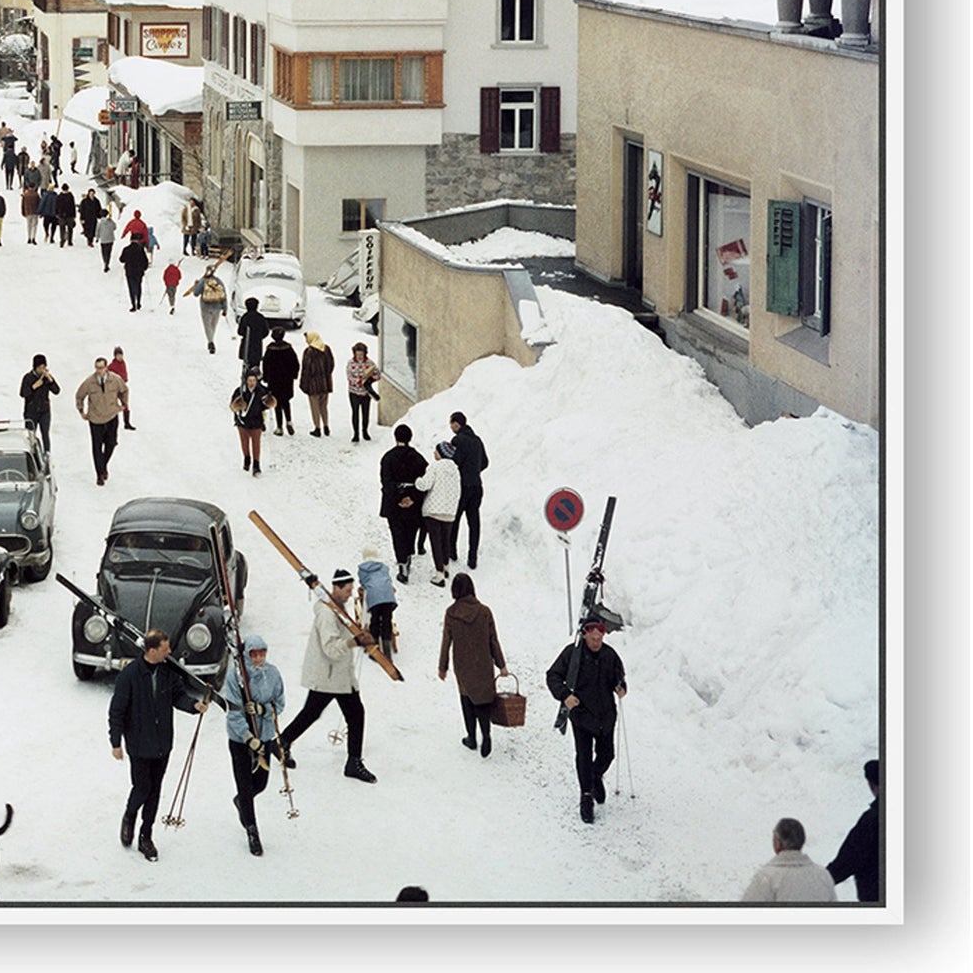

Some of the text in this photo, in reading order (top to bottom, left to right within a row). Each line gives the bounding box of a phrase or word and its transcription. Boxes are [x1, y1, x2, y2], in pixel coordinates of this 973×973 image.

[143, 28, 187, 39] SHOPPING
[109, 101, 135, 112] SPORT
[366, 235, 374, 290] COIFFEUR
